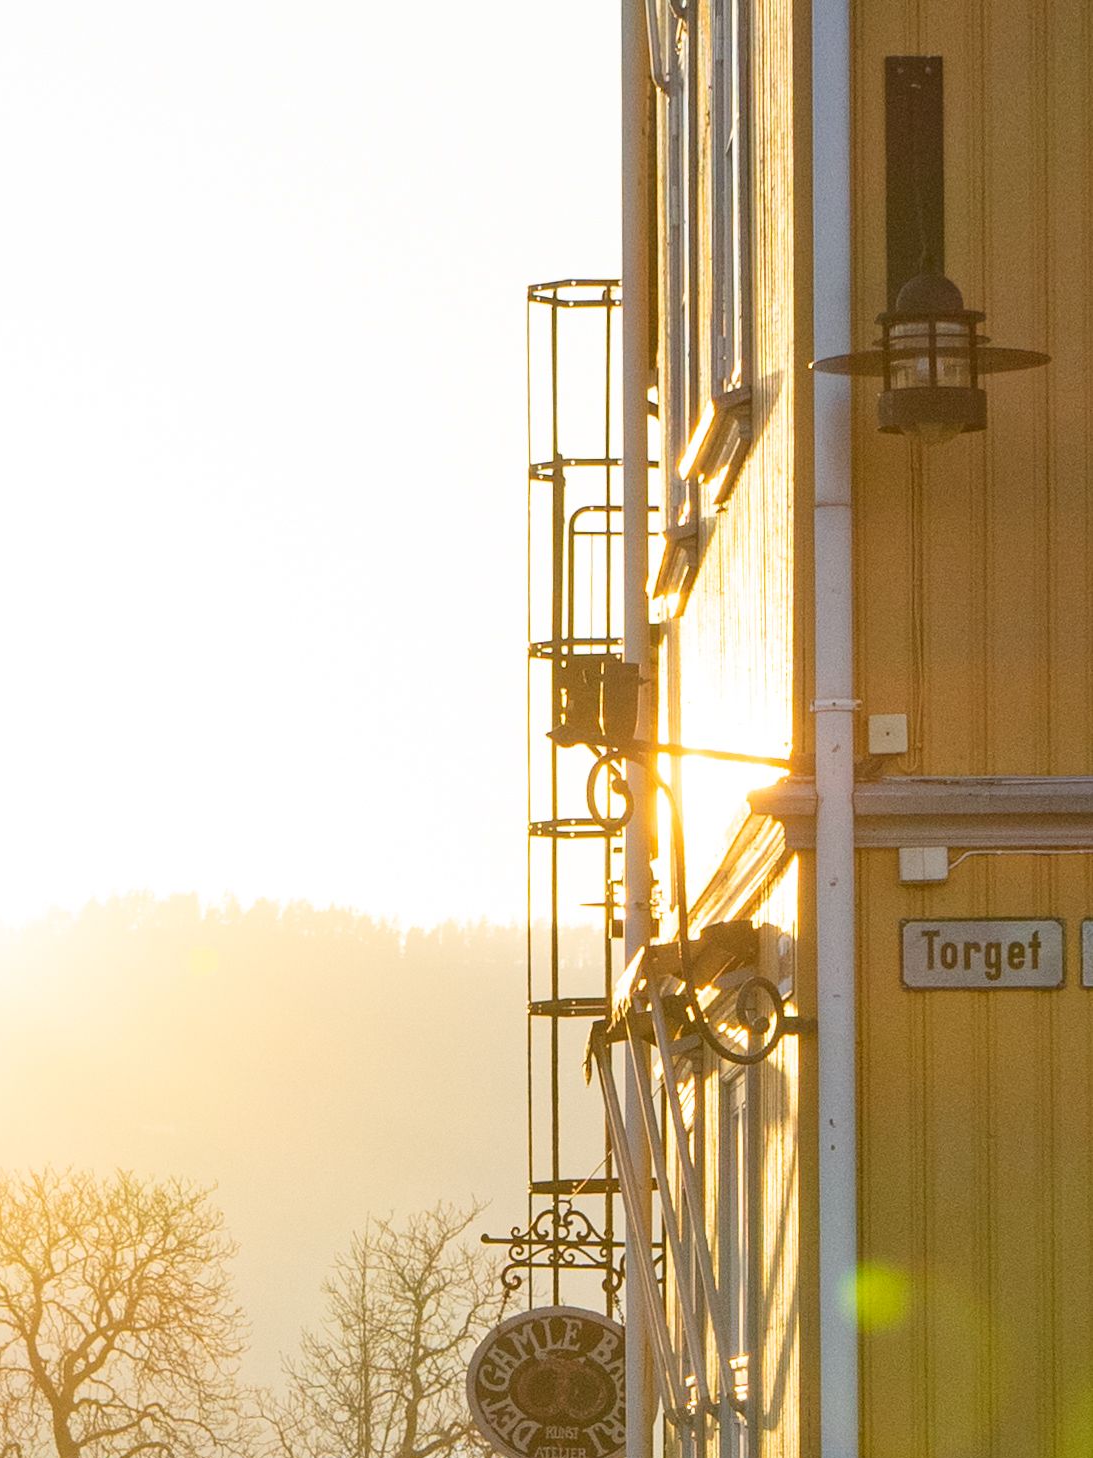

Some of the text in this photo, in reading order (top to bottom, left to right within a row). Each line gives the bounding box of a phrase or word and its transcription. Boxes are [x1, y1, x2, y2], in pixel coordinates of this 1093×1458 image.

[922, 930, 1041, 981] Torget
[479, 1318, 583, 1392] GAMLE
[480, 1395, 542, 1453] DET
[546, 1426, 580, 1439] KUNST
